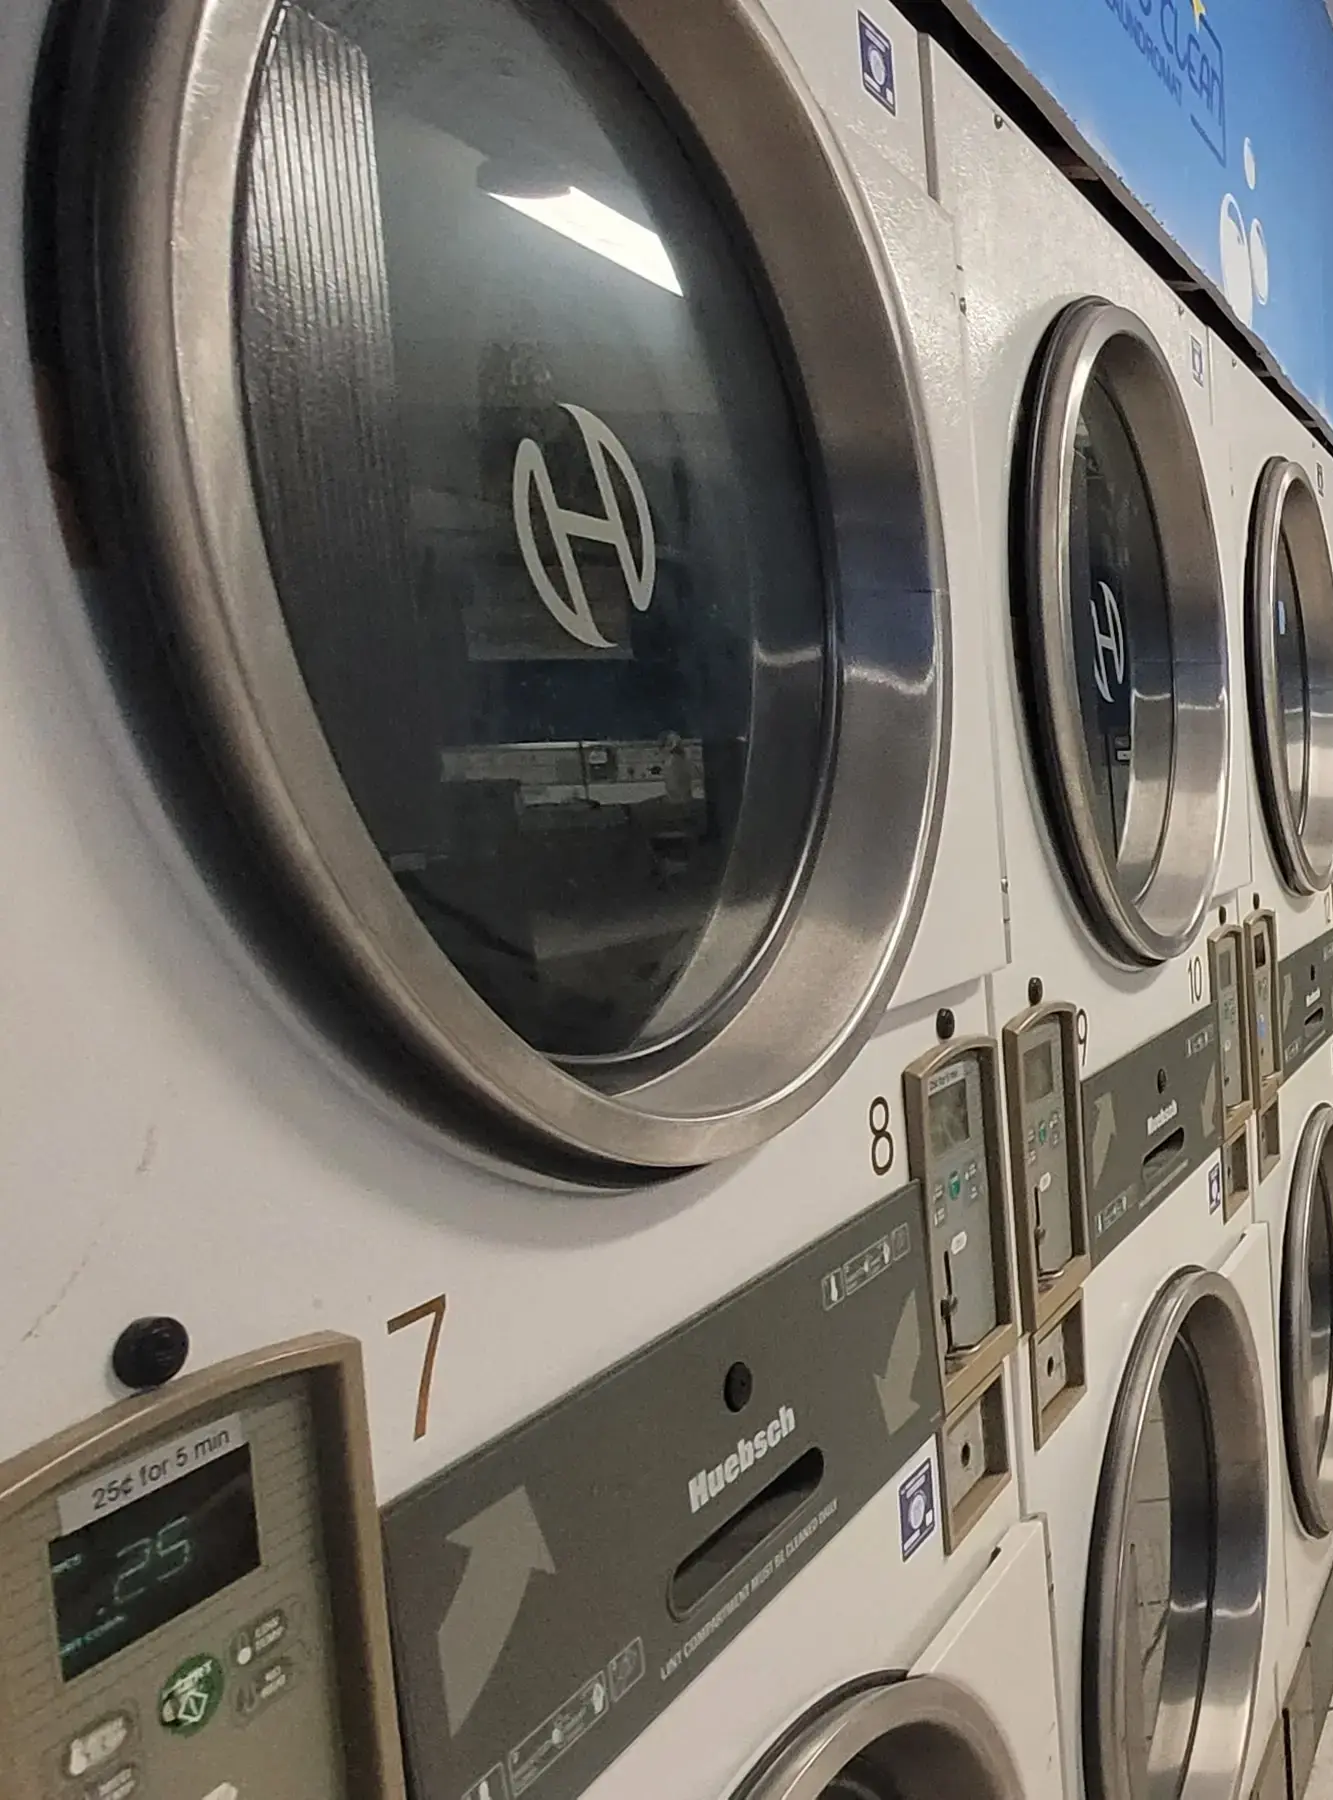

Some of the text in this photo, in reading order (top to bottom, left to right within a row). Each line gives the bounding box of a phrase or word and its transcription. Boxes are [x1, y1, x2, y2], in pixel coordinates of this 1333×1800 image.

[1187, 956, 1202, 1004] 10
[1076, 1007, 1088, 1067] 9
[868, 1096, 895, 1176] 8
[386, 1294, 447, 1442] 7
[91, 1428, 230, 1511] 25¢ for 5 min
[687, 1404, 797, 1514] Huebsch
[659, 1649, 683, 1681] LINT
[683, 1583, 750, 1661] COMPARTMENT
[751, 1563, 775, 1592] MUST
